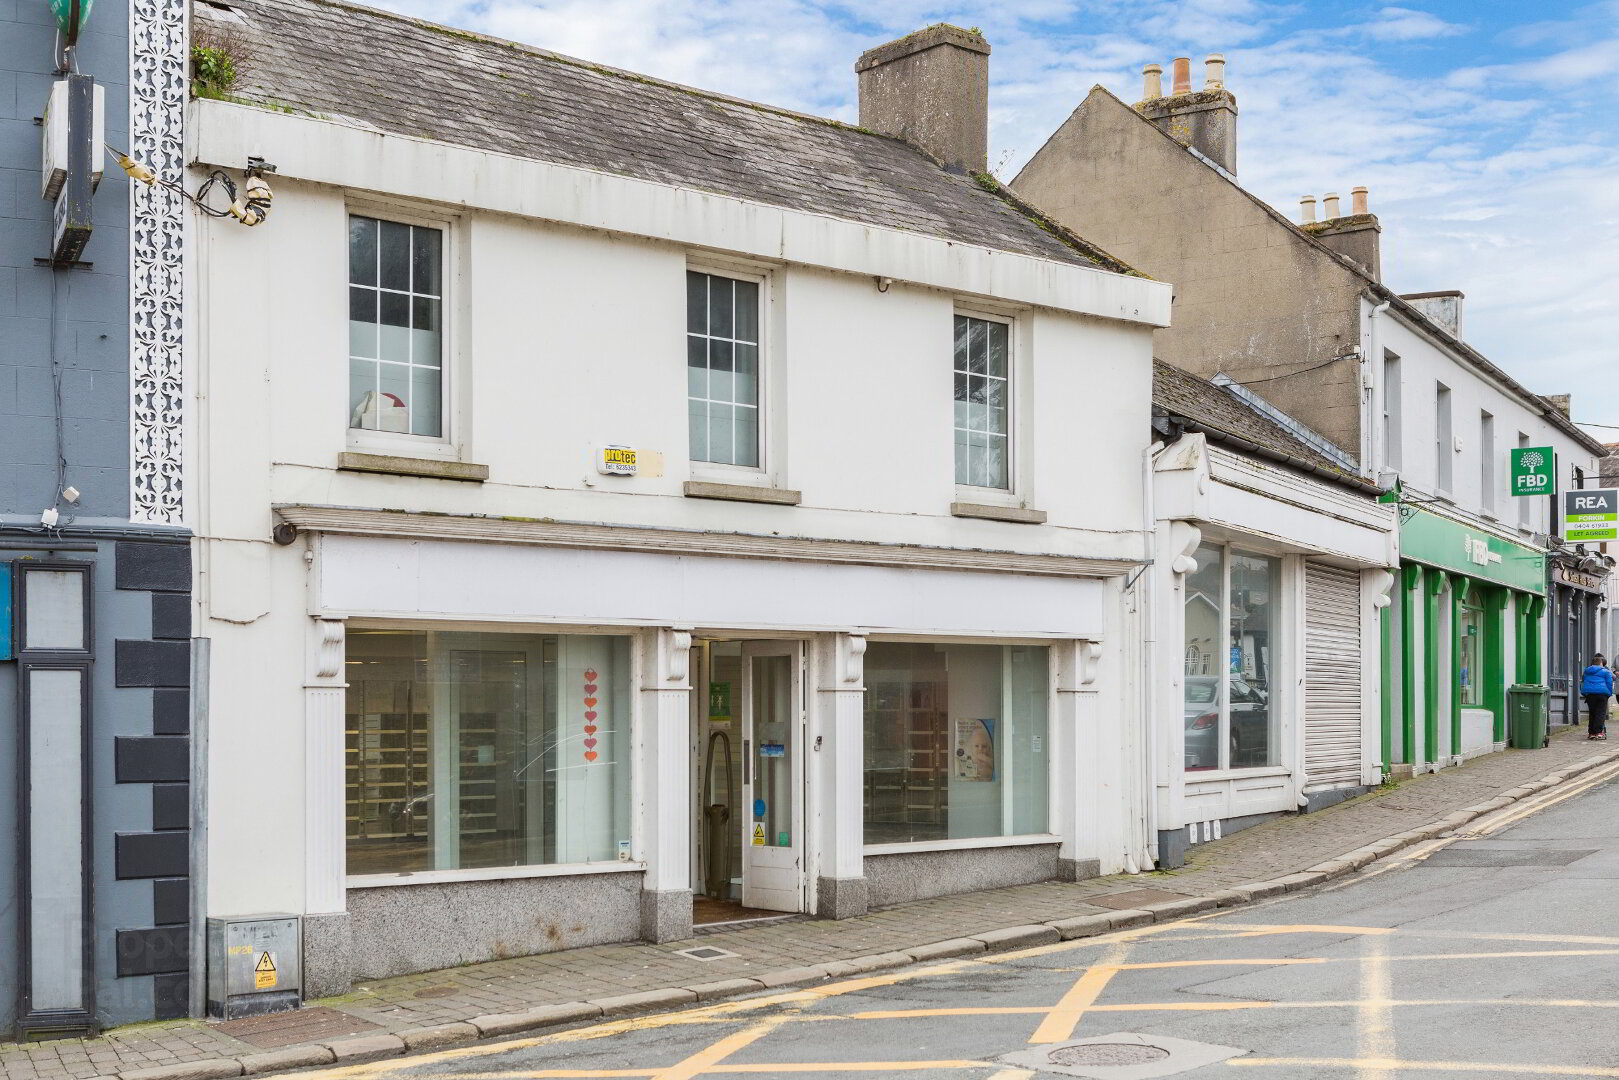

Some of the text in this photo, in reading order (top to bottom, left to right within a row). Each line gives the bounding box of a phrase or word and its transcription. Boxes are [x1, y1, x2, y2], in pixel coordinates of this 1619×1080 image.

[1517, 474, 1548, 487] FBD
[1575, 496, 1608, 509] REA
[1578, 514, 1605, 522] FORKIN
